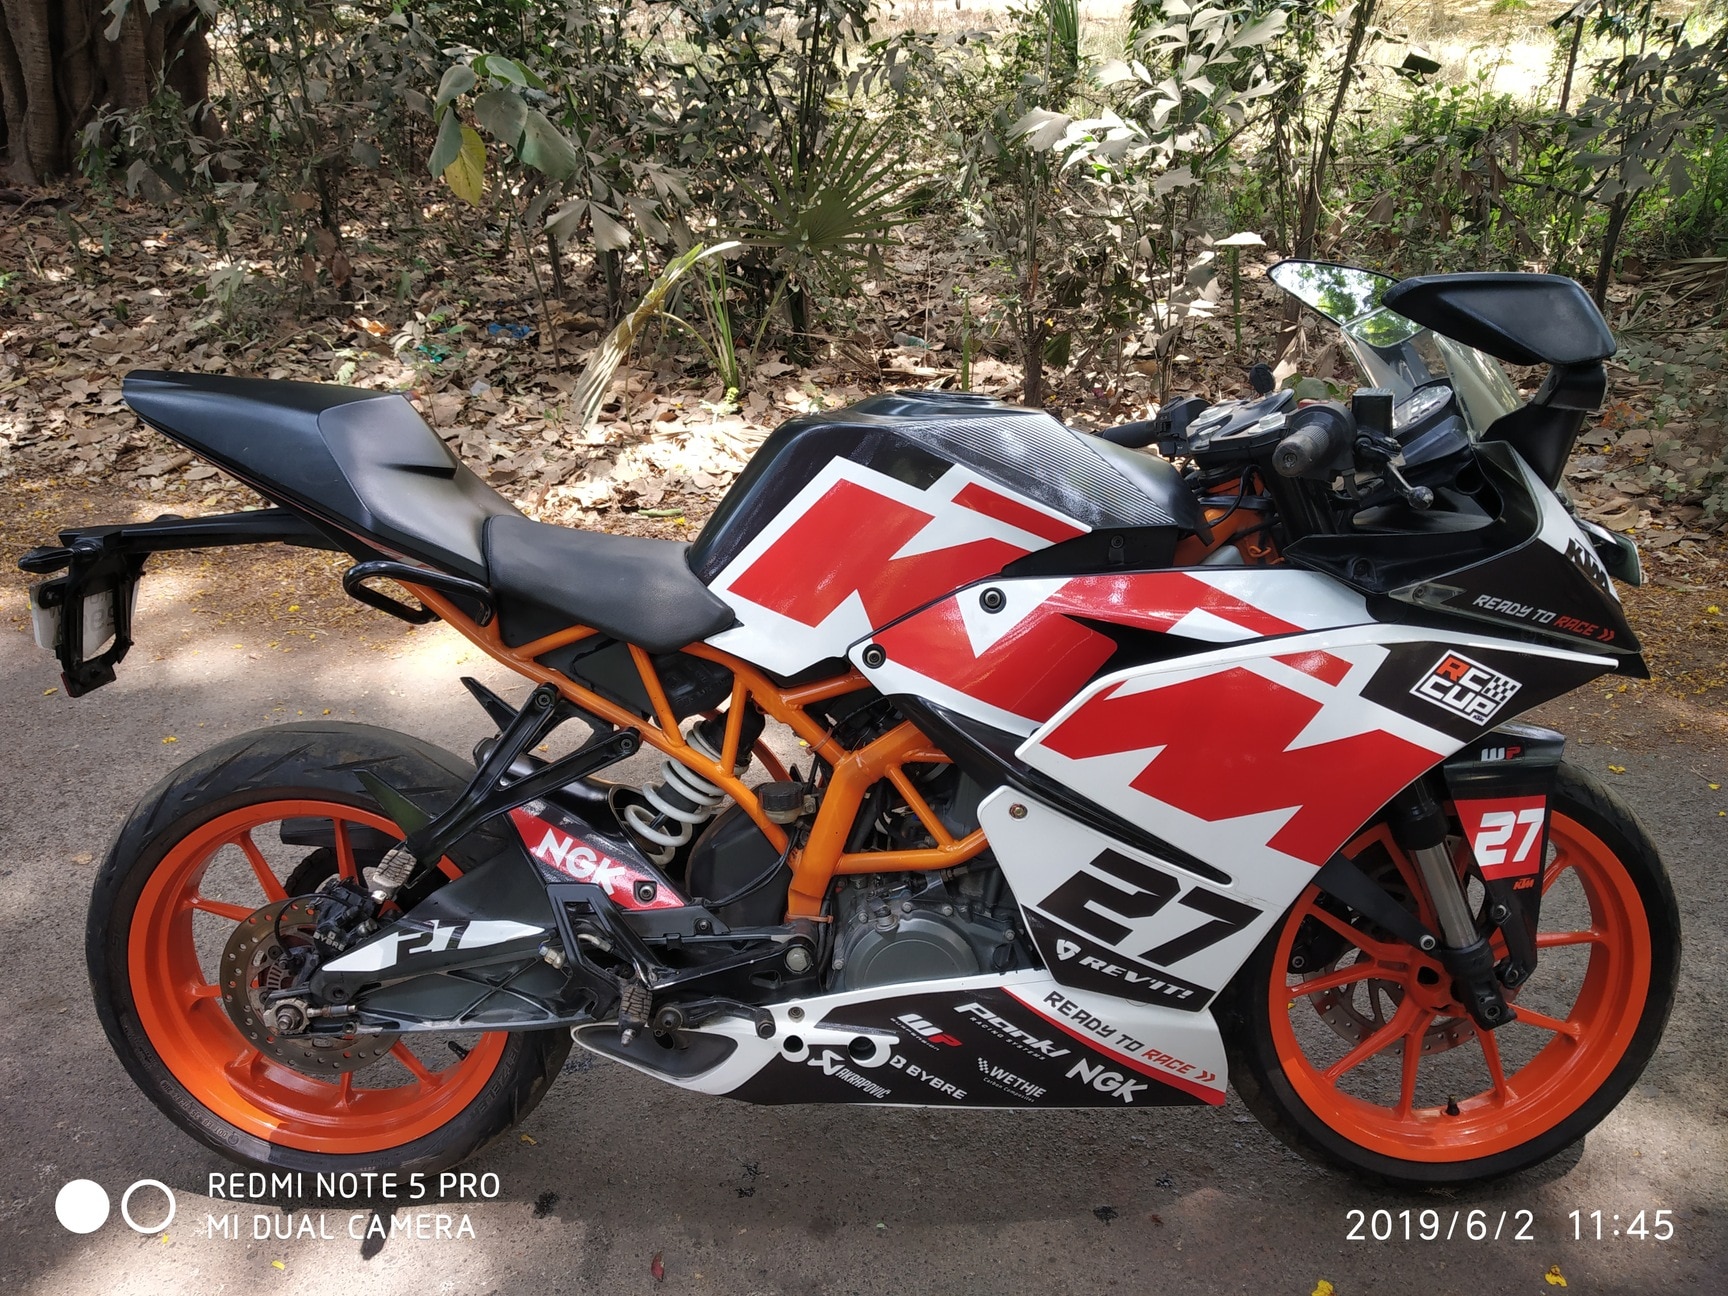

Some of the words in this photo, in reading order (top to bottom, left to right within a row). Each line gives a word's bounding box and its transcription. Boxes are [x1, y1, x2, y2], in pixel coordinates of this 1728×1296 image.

[1472, 594, 1534, 619] READY
[1532, 608, 1557, 625] TO
[1553, 614, 1599, 638] RACE
[1419, 674, 1498, 716] CUP
[1480, 746, 1522, 762] WP
[1474, 807, 1546, 867] 27
[536, 828, 626, 896] NGK
[1513, 876, 1535, 890] KTM
[1036, 847, 1264, 967] 27
[1078, 955, 1195, 1000] REV'IT!
[897, 1013, 963, 1047] WP
[969, 1016, 1004, 1038] RACING
[1005, 1038, 1046, 1060] SYSTEMS
[1043, 990, 1117, 1038] READY
[1115, 1033, 1145, 1053] TO
[1141, 1048, 1196, 1075] RACE
[905, 1064, 968, 1100] BYBRE
[990, 1065, 1047, 1098] WETHJE
[1065, 1057, 1148, 1104] NGK
